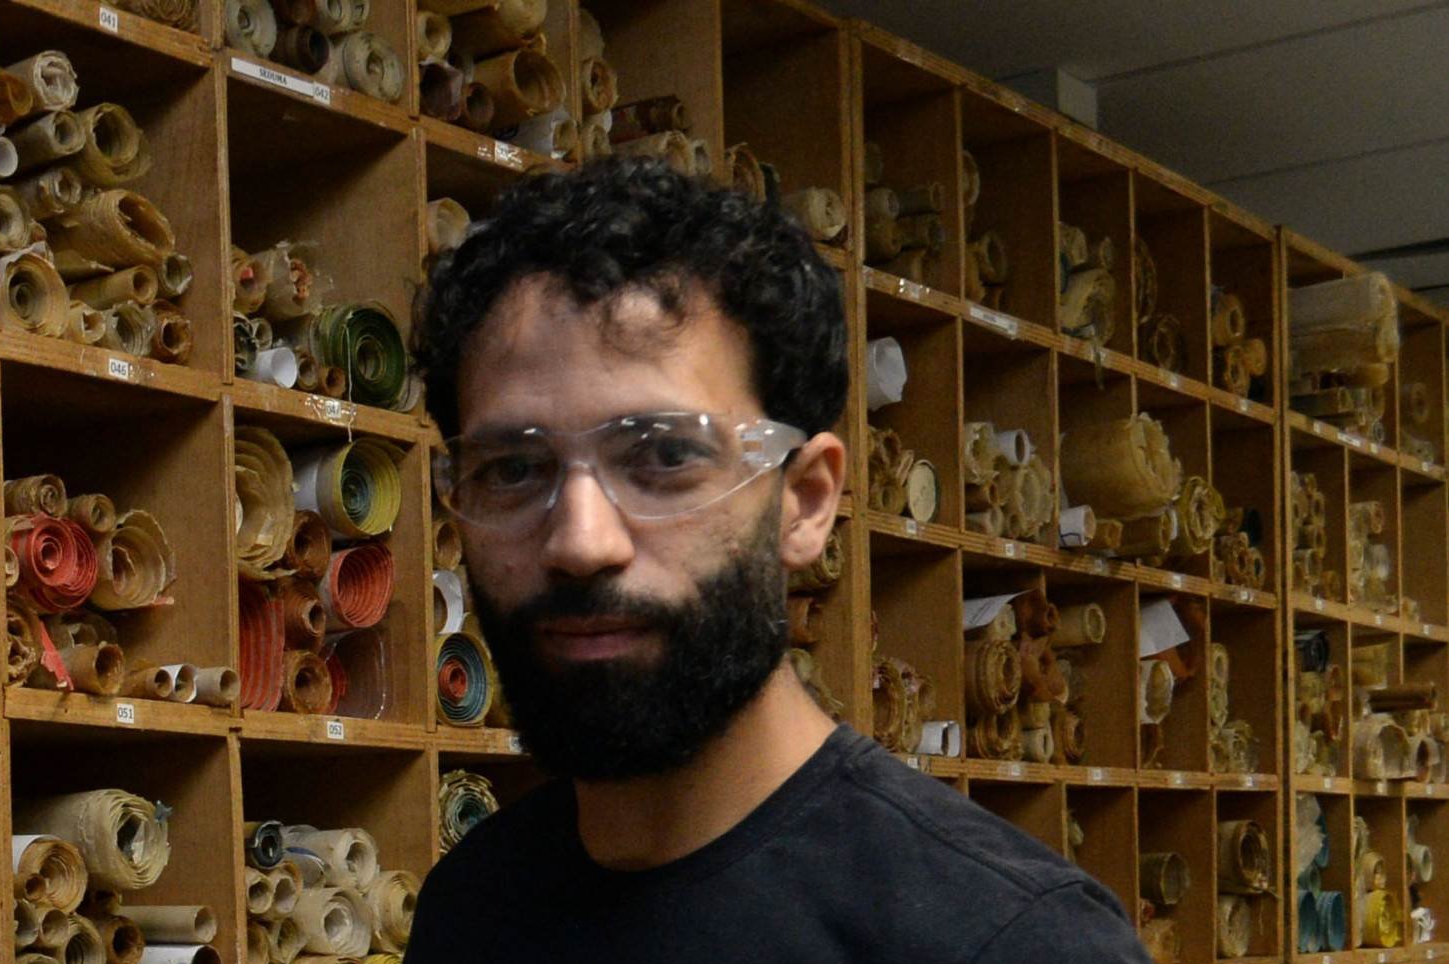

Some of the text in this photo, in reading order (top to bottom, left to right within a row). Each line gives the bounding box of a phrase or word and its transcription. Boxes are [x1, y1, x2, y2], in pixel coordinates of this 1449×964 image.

[315, 86, 329, 100] 042
[110, 361, 127, 376] 046
[117, 707, 133, 720] 051
[329, 724, 342, 735] 052
